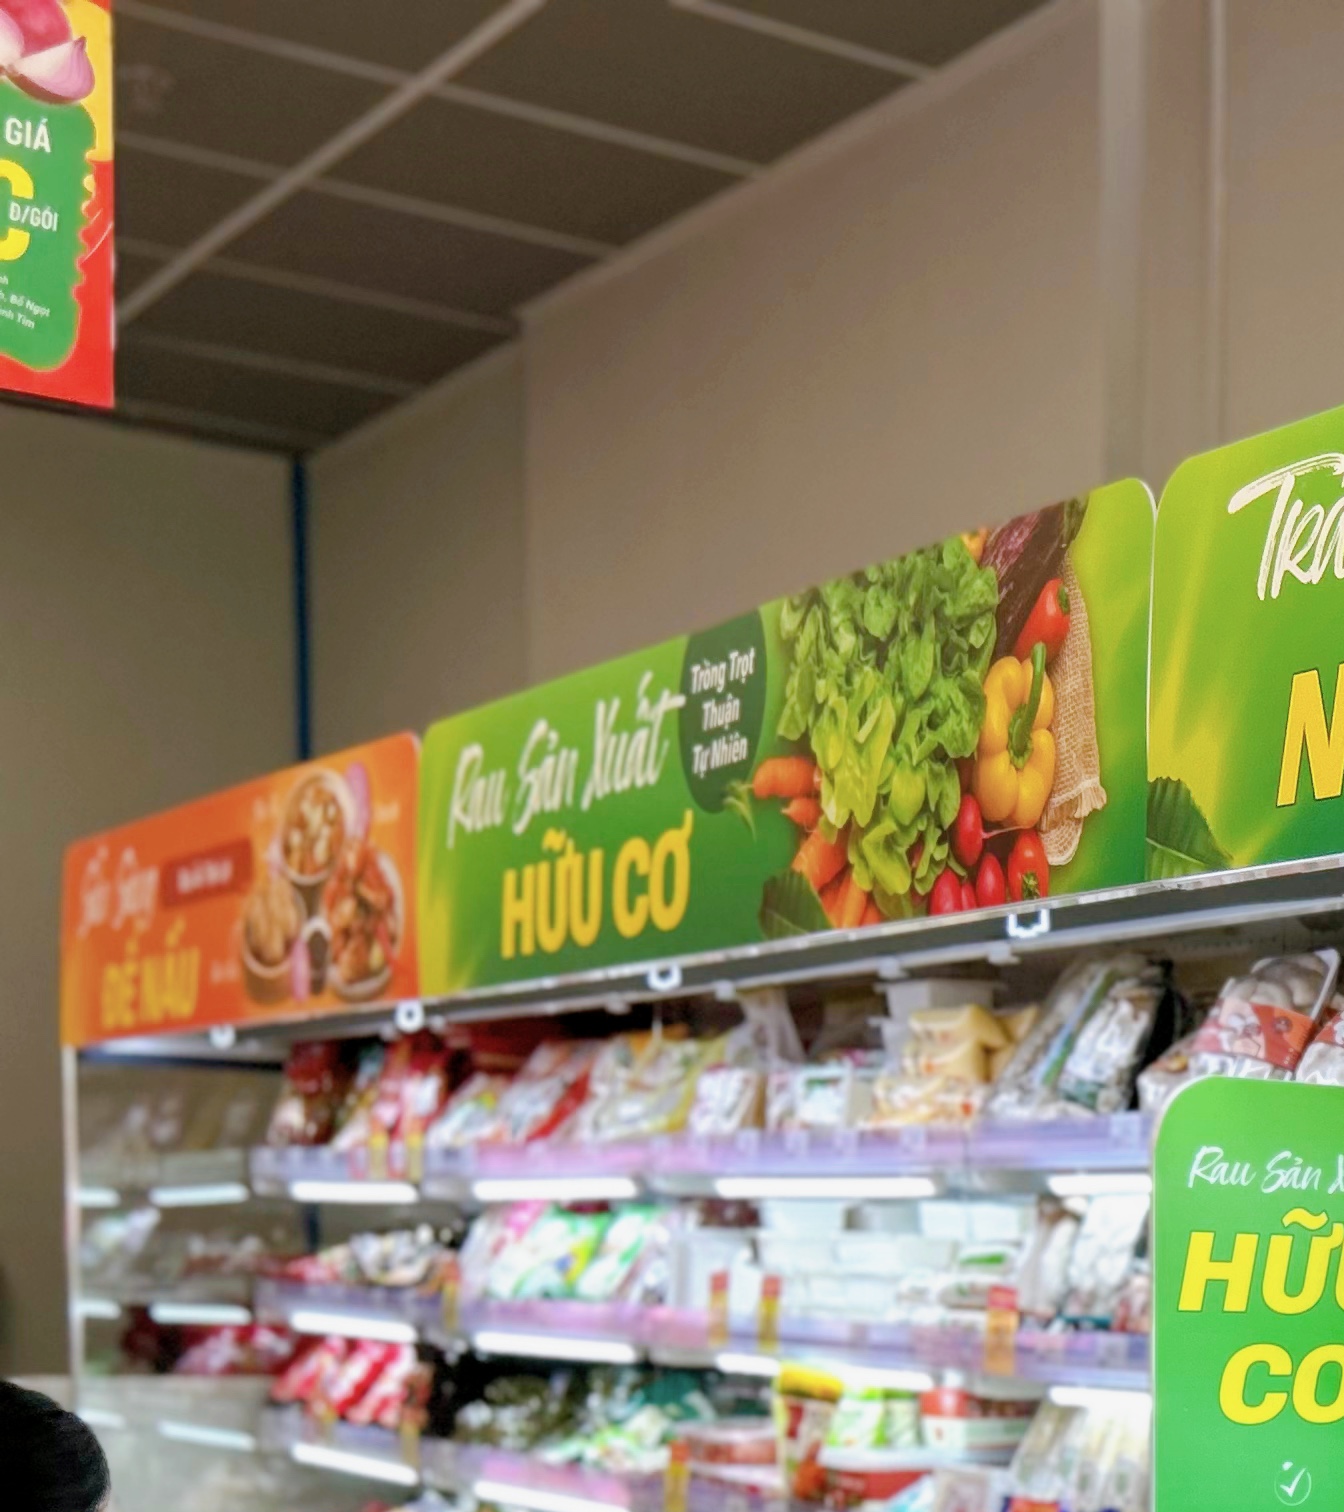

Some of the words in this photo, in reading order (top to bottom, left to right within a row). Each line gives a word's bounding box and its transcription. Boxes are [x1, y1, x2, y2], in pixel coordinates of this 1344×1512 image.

[5, 117, 51, 153] GIÁ
[447, 742, 507, 849] Rau
[500, 828, 603, 960] HỮU
[612, 810, 694, 938] CƠ
[1187, 1145, 1256, 1188] Rau
[1261, 1151, 1321, 1193] Sản
